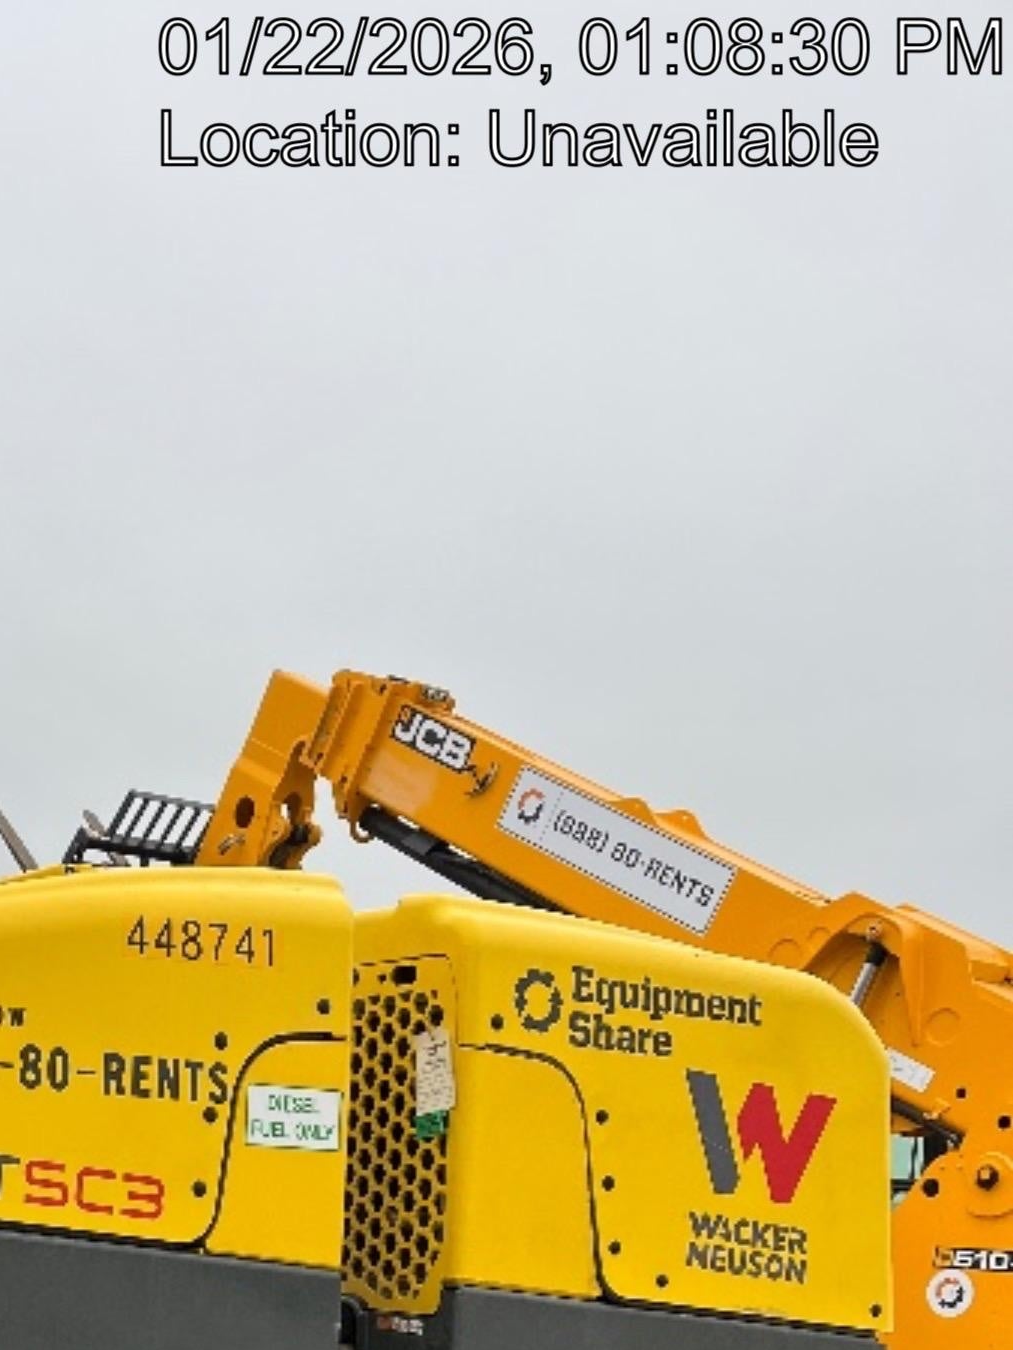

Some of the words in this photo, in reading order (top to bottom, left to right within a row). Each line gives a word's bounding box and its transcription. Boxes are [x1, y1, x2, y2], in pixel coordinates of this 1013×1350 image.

[394, 711, 472, 769] JCB
[554, 809, 610, 854] (888)
[126, 914, 276, 968] 448741
[571, 965, 763, 1027] Equipment
[568, 1010, 673, 1057] Share
[268, 1094, 321, 1114] DIESEL
[251, 1119, 290, 1138] FUEL
[295, 1122, 336, 1141] ONLY
[688, 1210, 809, 1255] WACKER
[685, 1241, 808, 1286] NEUSON
